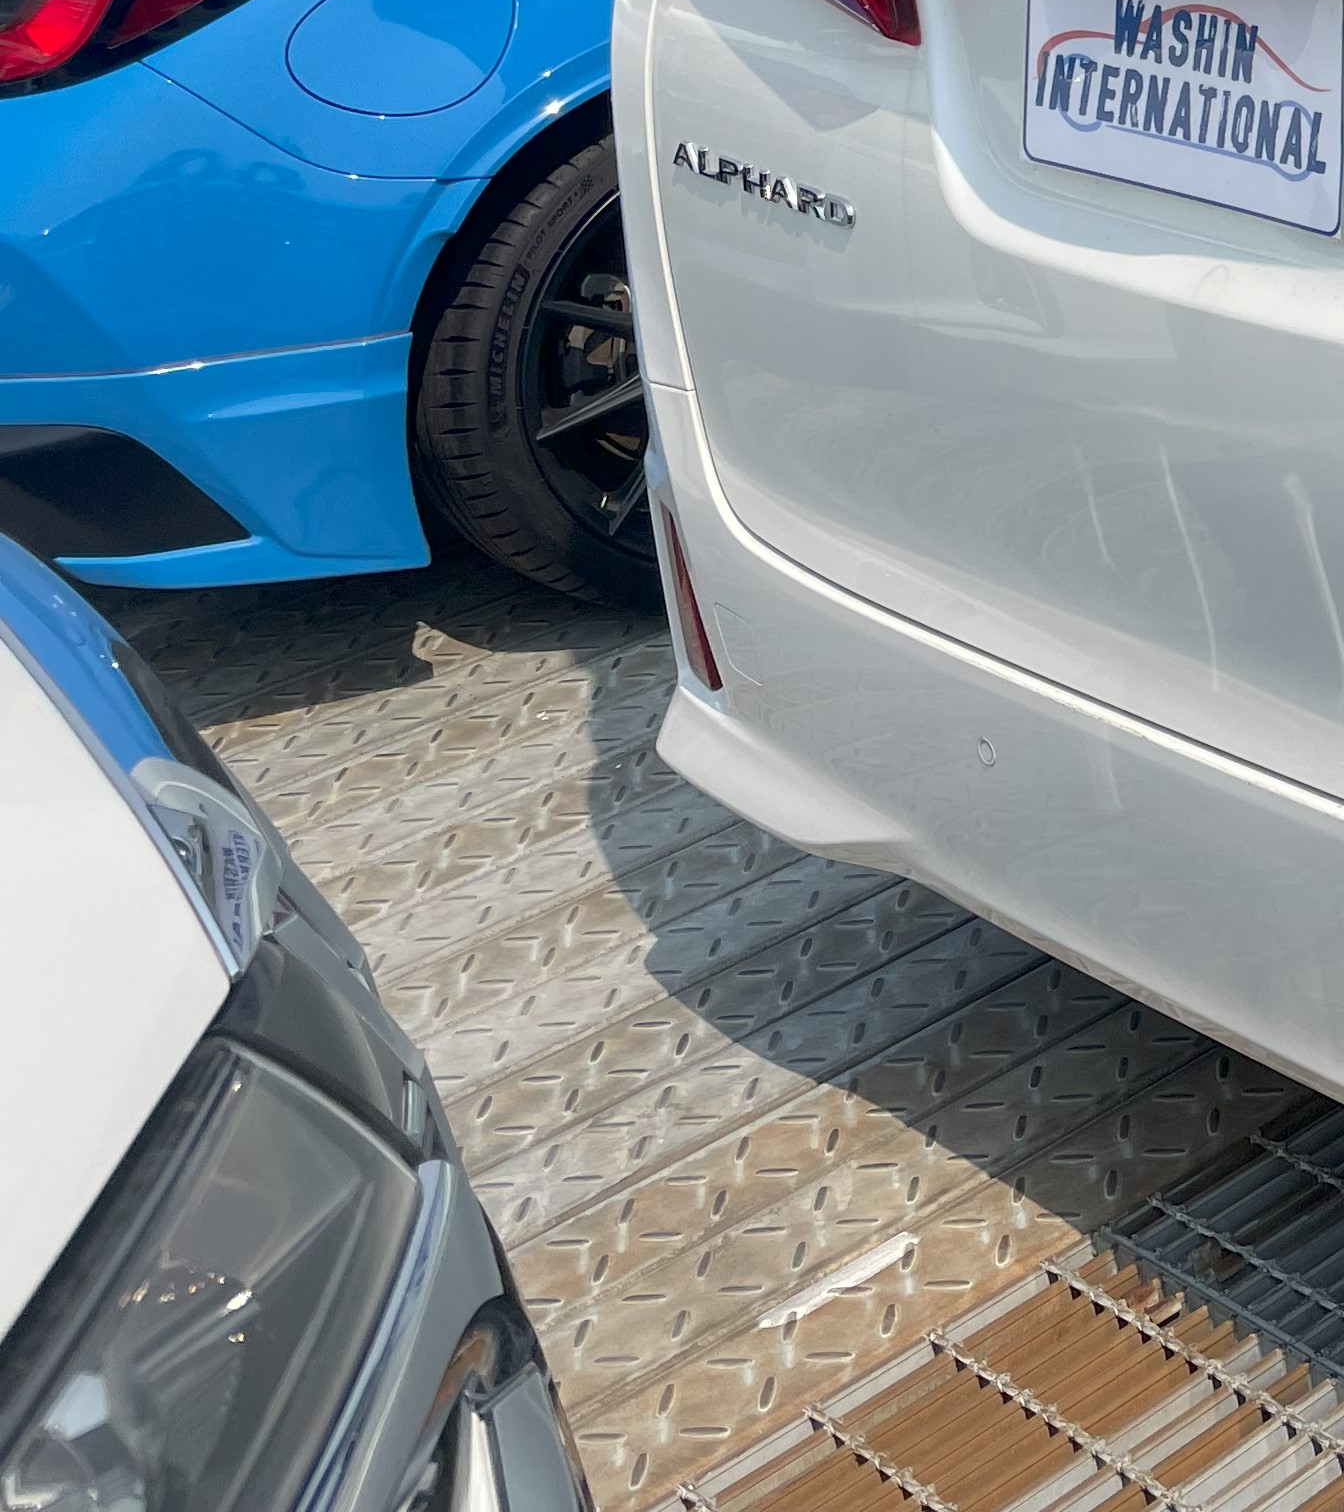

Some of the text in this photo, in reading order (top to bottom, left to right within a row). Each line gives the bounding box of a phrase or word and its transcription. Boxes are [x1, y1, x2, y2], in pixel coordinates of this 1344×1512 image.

[1034, 50, 1327, 175] INTERNATIONAL
[672, 139, 857, 229] ALPHARD
[487, 271, 526, 395] MICHELIN
[527, 229, 548, 261] PILOT
[547, 196, 574, 228] SPORT
